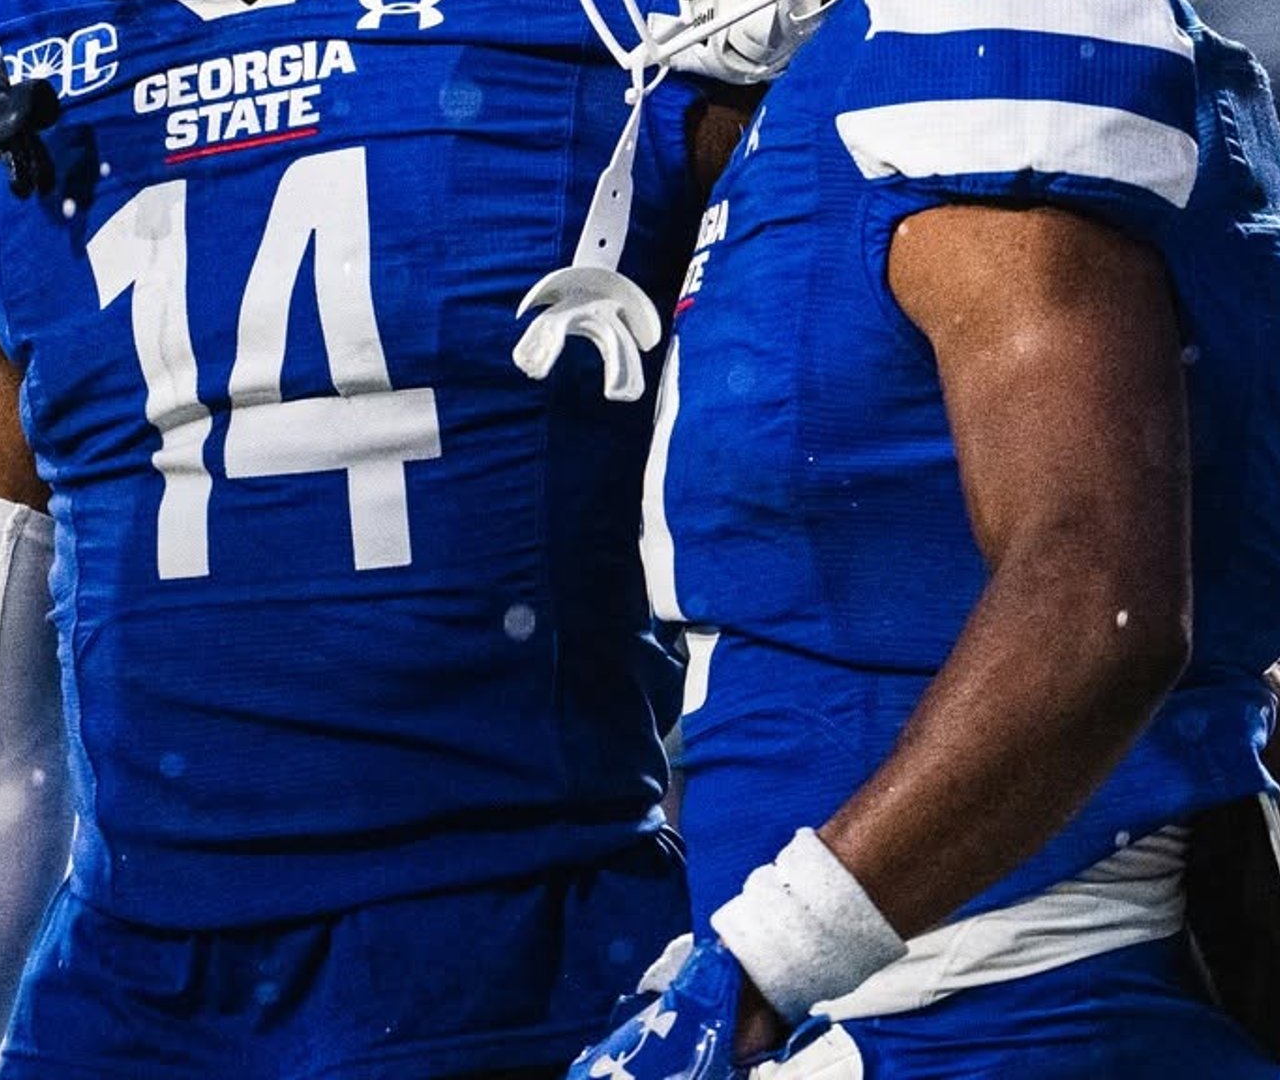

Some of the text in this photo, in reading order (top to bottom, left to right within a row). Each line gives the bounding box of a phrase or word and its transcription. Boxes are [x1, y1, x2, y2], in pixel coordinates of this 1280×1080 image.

[133, 39, 357, 114] GEORGIA
[165, 83, 321, 150] STATE
[86, 146, 442, 580] 14
